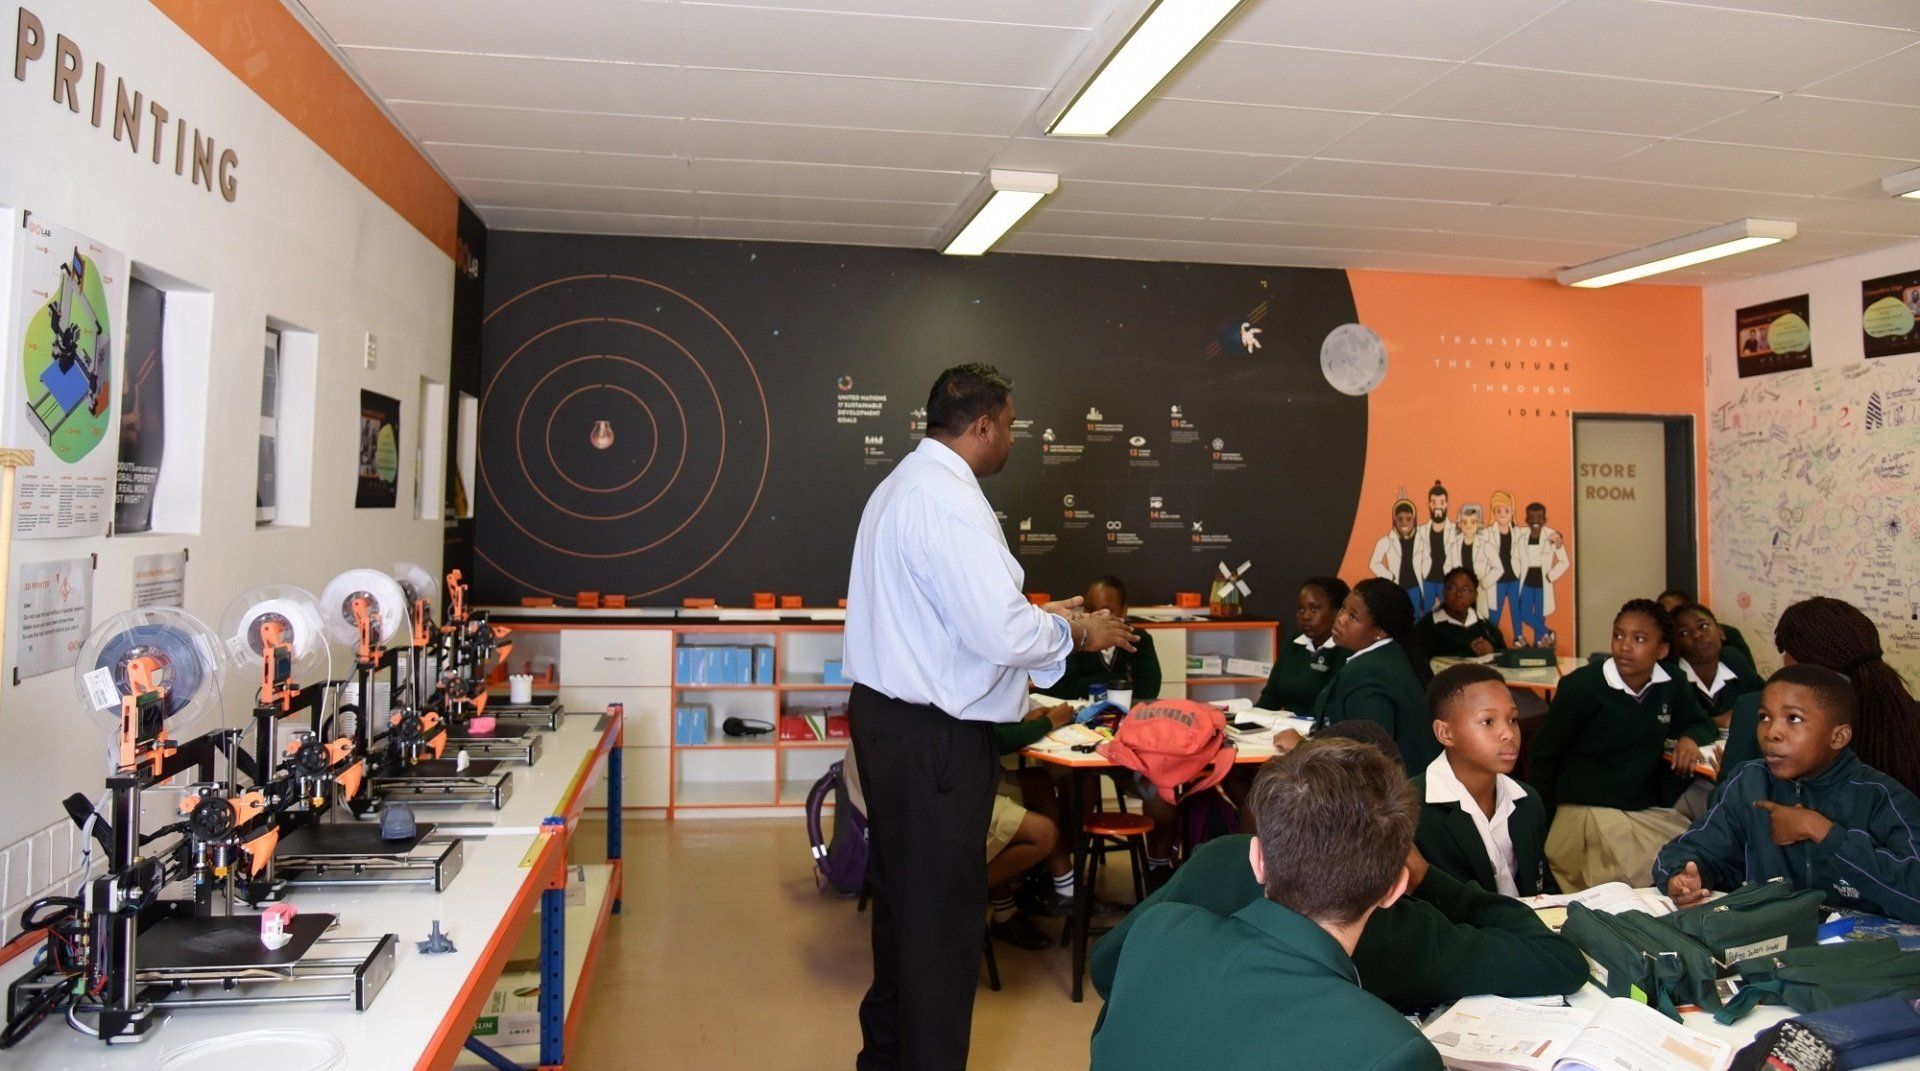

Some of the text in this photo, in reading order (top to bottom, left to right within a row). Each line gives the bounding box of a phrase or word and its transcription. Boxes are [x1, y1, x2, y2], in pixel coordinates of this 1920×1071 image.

[14, 6, 240, 203] PRINTING
[1440, 335, 1570, 349] TRANSFORM
[1434, 358, 1571, 371] THE FUTURE
[1472, 383, 1571, 395] THROUGH
[1507, 408, 1571, 418] IDEAS
[118, 472, 133, 482] OBAL
[1580, 463, 1637, 478] STORE
[116, 494, 124, 504] ST
[1586, 486, 1636, 501] ROOM
